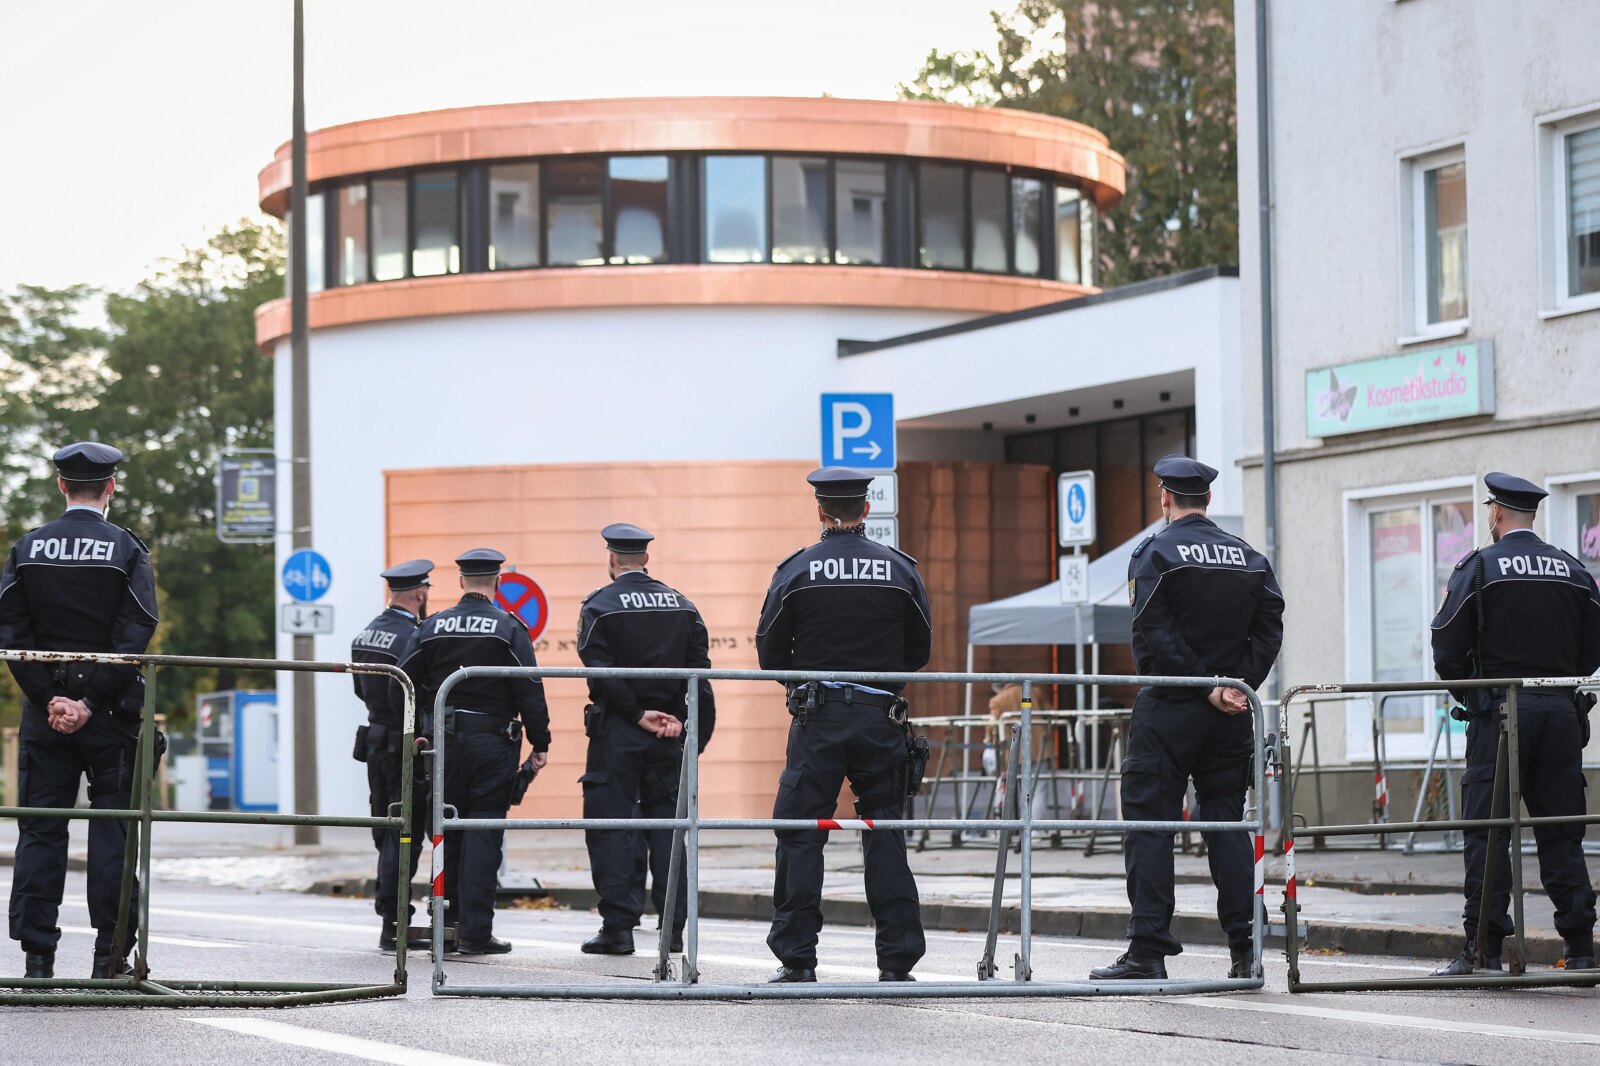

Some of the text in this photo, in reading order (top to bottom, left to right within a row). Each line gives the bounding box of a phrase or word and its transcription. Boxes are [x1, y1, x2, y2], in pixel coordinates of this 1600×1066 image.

[1366, 371, 1467, 408] Kosmetikstudio
[831, 402, 872, 460] P
[867, 526, 891, 540] ags
[29, 537, 115, 561] POLIZEI
[1176, 544, 1247, 567] POLIZEI
[809, 557, 892, 581] POLIZEI
[1498, 555, 1570, 578] POLIZEI
[619, 592, 680, 609] POLIZEI
[433, 615, 498, 634] POLIZEI
[355, 629, 398, 650] POLIZEI
